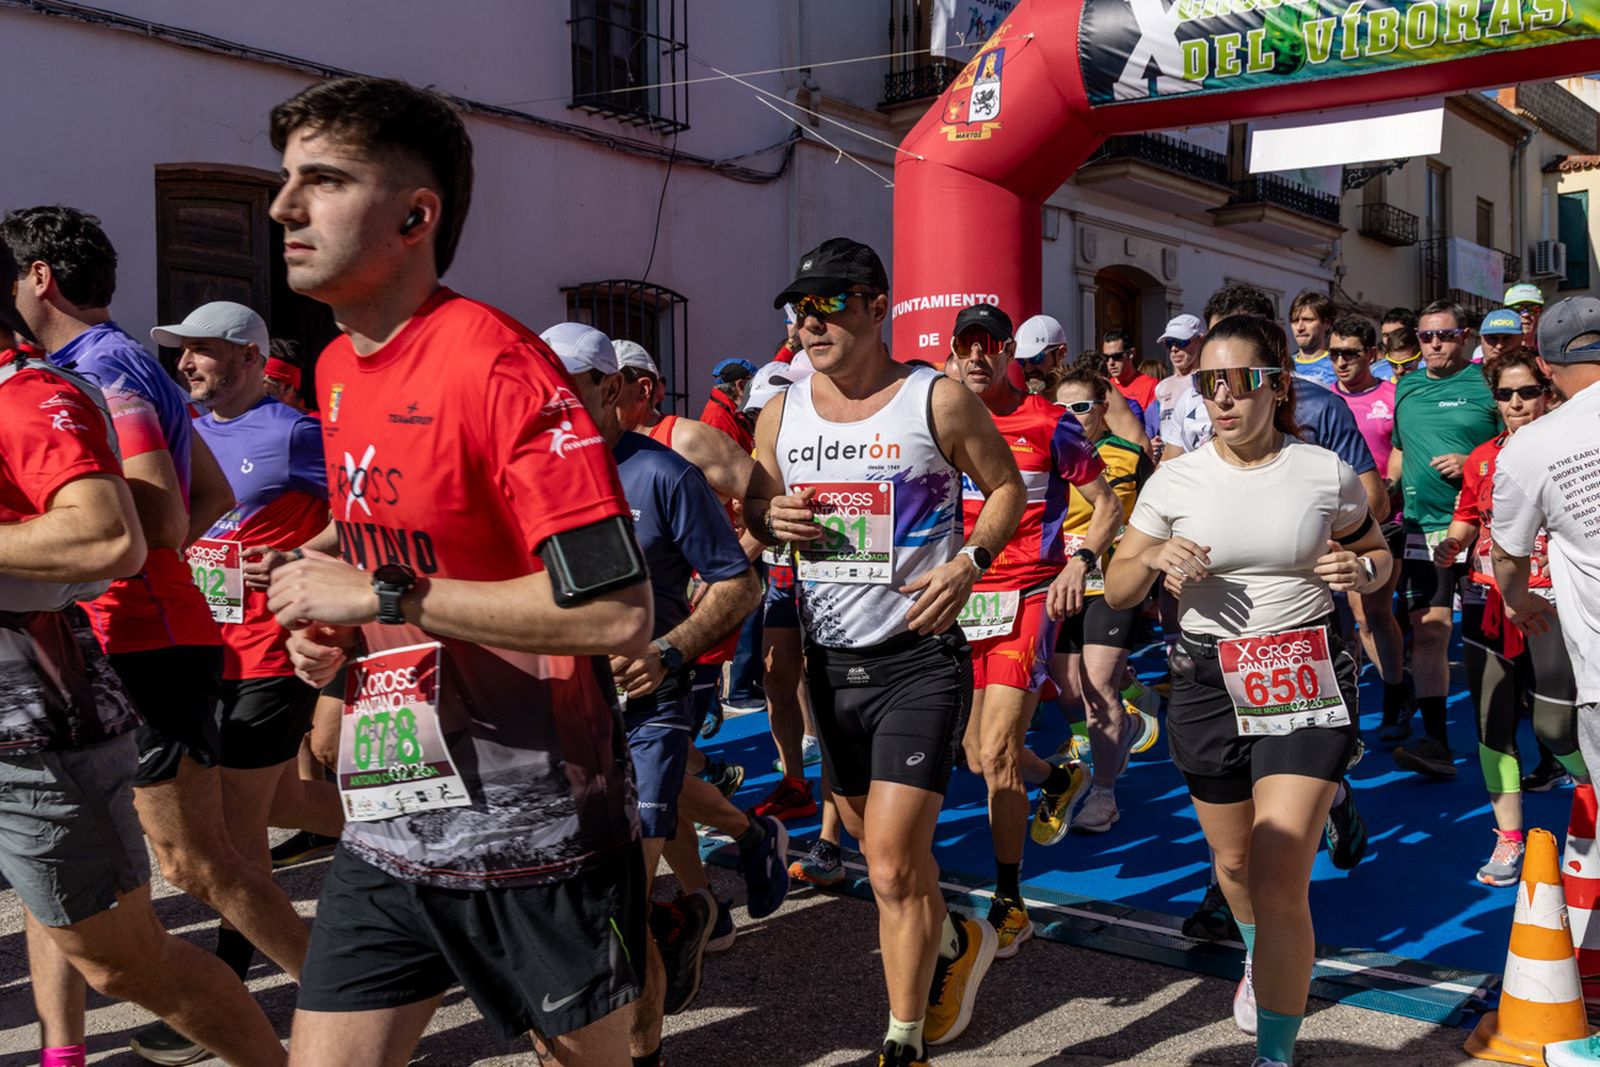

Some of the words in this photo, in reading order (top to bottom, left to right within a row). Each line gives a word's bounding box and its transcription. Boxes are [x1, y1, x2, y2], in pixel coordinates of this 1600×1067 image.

[1180, 28, 1275, 83] DEL
[1303, 0, 1567, 64] VÍBORAS
[1489, 319, 1514, 328] HOKA
[919, 333, 940, 348] DE
[788, 433, 901, 471] calderón
[1548, 464, 1556, 472] IN
[1556, 456, 1573, 468] THE
[1573, 448, 1600, 461] EARLY
[1552, 464, 1583, 482] BROKEN
[818, 492, 874, 506] CROSS
[1564, 487, 1584, 500] WITH
[812, 506, 860, 518] ANTANO
[1564, 501, 1581, 513] REAL
[1572, 506, 1597, 521] BRAND
[1583, 518, 1594, 528] TO
[191, 545, 226, 561] CROSS
[336, 520, 438, 575] ANTANO
[196, 566, 226, 597] 02
[1236, 642, 1255, 662] X
[1256, 640, 1313, 660] CROSS
[1237, 655, 1303, 675] PANTANO
[354, 667, 368, 699] X
[367, 666, 418, 696] CROSS
[1245, 664, 1319, 707] 650
[353, 692, 404, 719] PANTANO
[354, 707, 421, 771] 678
